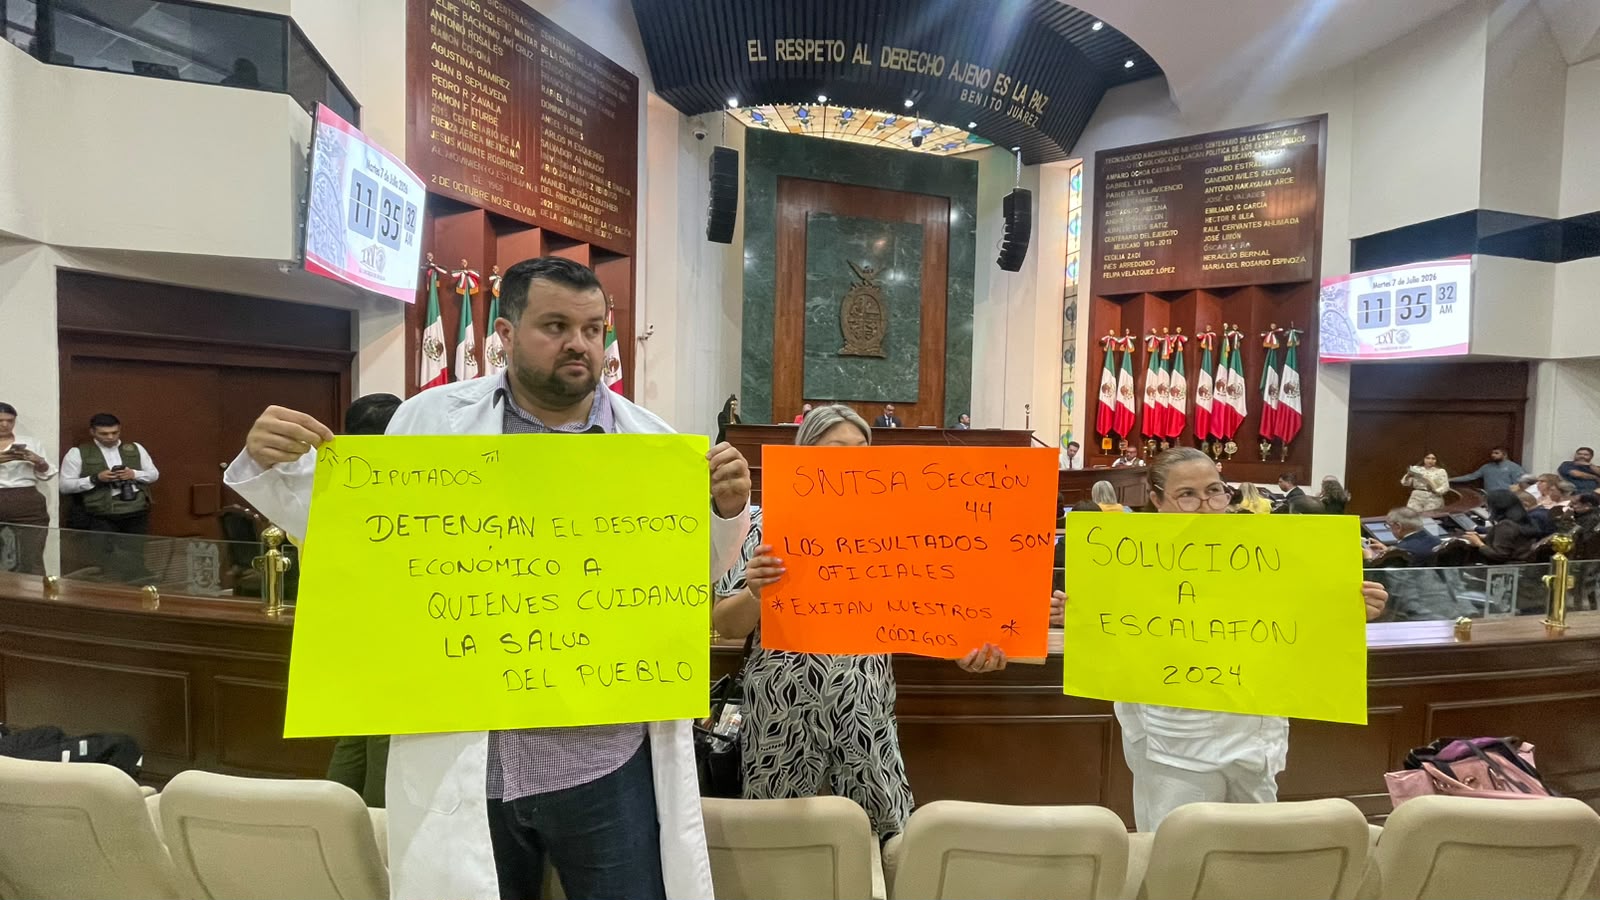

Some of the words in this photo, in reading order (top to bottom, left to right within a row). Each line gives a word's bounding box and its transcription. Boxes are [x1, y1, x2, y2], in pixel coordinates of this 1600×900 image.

[430, 8, 465, 35] ANTONIO
[467, 29, 504, 56] ROSALES
[462, 10, 500, 40] BACHOMO
[515, 44, 534, 60] CRUZ
[514, 28, 538, 49] MILITAR
[461, 41, 491, 65] CORONA
[540, 43, 549, 56] DE
[431, 42, 475, 71] AGUSTINA
[477, 66, 511, 90] RAMIREZ
[747, 40, 767, 62] EL
[775, 39, 845, 62] RESPETO
[852, 43, 871, 65] AL
[880, 46, 945, 77] DERECHO
[948, 60, 991, 89] AJENO
[993, 72, 1011, 96] ES
[1012, 80, 1028, 104] LA
[1029, 89, 1048, 114] PAZ
[431, 59, 454, 76] JUAN
[456, 70, 462, 80] B
[464, 75, 508, 103] SEPULVEDA
[431, 73, 460, 94] PEDRO
[462, 88, 469, 98] R
[541, 84, 564, 103] RAFAEL
[960, 88, 1002, 111] BENITO
[431, 88, 460, 110] RAMON
[463, 103, 470, 112] F
[471, 107, 499, 127] ITURBE
[541, 99, 568, 118] DOMINGO
[431, 115, 458, 135] FUERZA
[486, 138, 519, 159] MEXICANA
[452, 112, 498, 139] CENTENARIO
[500, 134, 510, 144] DE
[512, 138, 521, 149] LA
[563, 124, 584, 140] FLORES
[456, 139, 486, 159] KUMATE
[1204, 137, 1239, 149] CENTENARIO
[1239, 136, 1247, 144] DE
[1241, 143, 1253, 151] LOS
[540, 139, 572, 159] SALVADOR
[574, 156, 605, 174] ALVARADO
[1223, 151, 1255, 162] MEXICANOS
[1106, 172, 1129, 180] AMPARO
[1130, 168, 1150, 177] OCHOA
[1204, 164, 1233, 175] GENARO
[1204, 174, 1234, 184] CANDIDO
[1235, 171, 1259, 179] AVILES
[1261, 167, 1292, 177] INZUNZA
[540, 185, 554, 197] DEL
[540, 175, 568, 193] MANUEL
[589, 195, 619, 213] CLOUTHIER
[1105, 180, 1132, 190] GABRIEL
[1134, 178, 1153, 187] LEYVA
[1105, 191, 1126, 199] PABLO
[1137, 183, 1183, 194] VILLAVICENCIO
[1204, 184, 1233, 194] ANTONIO
[1234, 180, 1272, 190] NAKAYAMA
[1274, 176, 1295, 186] ARCE
[431, 174, 437, 183] 2
[438, 176, 450, 187] DE
[452, 180, 490, 201] OCTUBRE
[491, 195, 502, 205] NO
[503, 199, 512, 210] SE
[513, 202, 536, 218] OLVIDA
[1204, 193, 1223, 203] JOSÉ
[355, 182, 372, 228] 11
[381, 198, 401, 241] 35
[406, 206, 415, 228] 32
[540, 197, 553, 209] 2021
[600, 220, 607, 229] LA
[1204, 205, 1234, 214] EMILIANO
[1204, 214, 1230, 223] HECTOR
[1238, 212, 1255, 220] OLEA
[540, 209, 549, 218] DE
[549, 211, 558, 221] LA
[585, 223, 594, 233] DE
[1221, 221, 1262, 231] CERVANTES
[1263, 217, 1300, 227] AHUMADA
[1104, 234, 1139, 243] CENTENARIO
[1139, 232, 1151, 240] DEL
[1152, 229, 1178, 238] EJERCITO
[1113, 242, 1141, 250] MEXICANO
[1203, 233, 1220, 242] JOSÉ
[1222, 231, 1242, 240] LIMÓN
[1103, 253, 1125, 261] CECILIA
[1119, 259, 1156, 269] ARREDONDO
[1202, 252, 1238, 261] HERACLIO
[1239, 250, 1271, 258] BERNAL
[1226, 261, 1239, 269] DEL
[1240, 259, 1271, 268] ROSARIO
[1272, 256, 1307, 265] ESPINOZA
[1156, 265, 1176, 275] LÓPEZ
[1372, 281, 1391, 289] Martes
[1392, 279, 1396, 287] 7
[1406, 275, 1420, 284] Julio
[1421, 272, 1437, 282] 2026
[1438, 286, 1454, 301] 32
[1363, 298, 1383, 324] 11
[1399, 292, 1428, 320] 35
[1439, 305, 1453, 314] AM
[792, 465, 909, 497] SNTSA
[921, 463, 1030, 491] SECCIÓN
[965, 501, 992, 521] 44
[366, 514, 535, 542] DETENGAN
[554, 516, 583, 538] EL
[595, 515, 699, 536] DESPOJO
[784, 536, 825, 557] LOS
[836, 534, 988, 554] RESULTADOS
[1009, 532, 1051, 552] SON
[1086, 526, 1281, 573] SOLUCION
[408, 545, 561, 577] ECONÓMICO
[583, 558, 602, 577] A
[817, 564, 956, 581] OFICIALES
[427, 591, 560, 621] QUIENES
[576, 584, 708, 611] CUIDAMOS
[1177, 580, 1196, 605] A
[887, 599, 993, 620] NUESTROS
[876, 623, 958, 646] CÓDIGOS
[1099, 612, 1297, 645] ESCALAFON
[444, 633, 477, 658] LA
[499, 628, 591, 654] SALUD
[502, 667, 557, 692] DEL
[576, 659, 693, 687] PUEBLO
[1163, 664, 1242, 686] 2024
